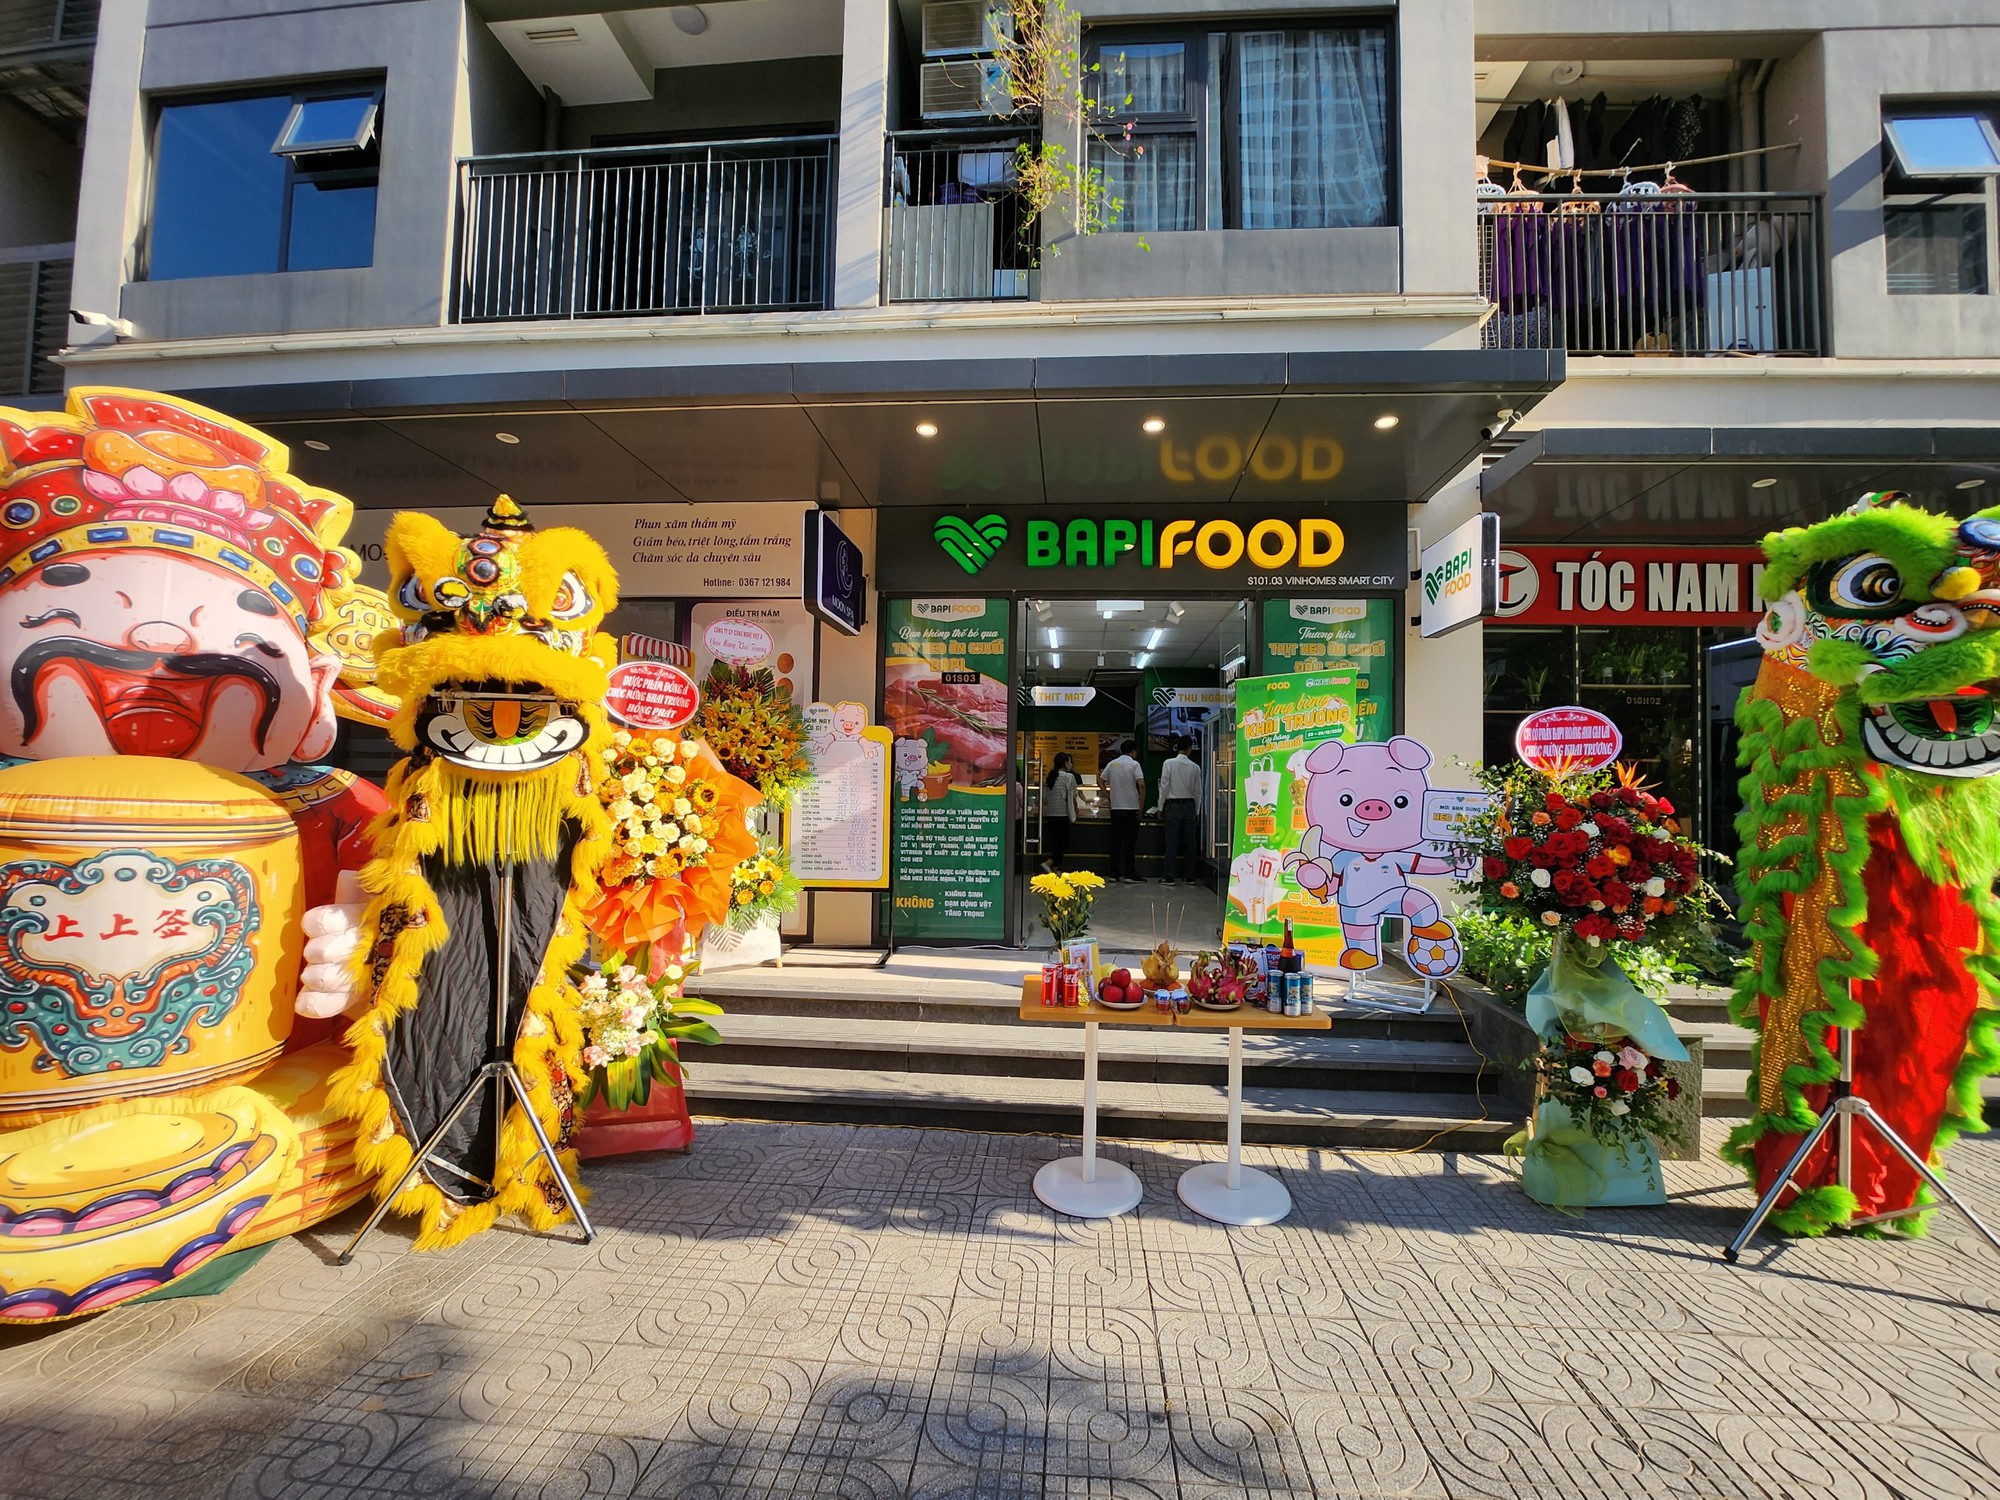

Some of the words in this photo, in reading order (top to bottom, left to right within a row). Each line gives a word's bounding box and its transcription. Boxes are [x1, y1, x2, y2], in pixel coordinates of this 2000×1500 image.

[634, 518, 661, 529] Phun
[665, 519, 687, 529] xăm
[1027, 519, 1154, 568] BAPI
[1159, 518, 1345, 569] FOOD
[632, 552, 663, 563] Chăm
[666, 552, 683, 563] sóc
[686, 552, 699, 562] da
[703, 552, 739, 564] chuyên
[742, 552, 762, 562] sâu
[1445, 547, 1472, 582] BAPI
[703, 578, 735, 587] Hotline:
[738, 577, 760, 587] 0367
[1247, 576, 1283, 586] S101.03
[1284, 576, 1337, 586] VINHOMES
[1338, 576, 1371, 586] SMART
[1372, 576, 1395, 586] CITY
[1445, 572, 1471, 598] FOOD
[1556, 551, 1635, 612] TÓC
[1648, 562, 1739, 612] NAM
[761, 608, 780, 617] NÁM
[930, 604, 951, 613] BAPI
[952, 605, 980, 613] FOOD
[1310, 606, 1331, 615] BAPI
[1332, 607, 1361, 615] FOOD
[899, 626, 921, 640] Bạn
[922, 628, 950, 640] không
[980, 630, 999, 639] qua
[922, 641, 947, 654] HEO
[949, 640, 966, 654] ĂN
[968, 638, 1004, 654] CHUỐI
[1268, 642, 1298, 658] THỊT
[1299, 643, 1326, 656] HEO
[1327, 641, 1346, 656] ĂN
[1347, 640, 1385, 656] CHUỐI
[929, 658, 966, 672] BAPI
[945, 674, 976, 682] 01S03
[1266, 681, 1291, 691] FOOD
[1244, 718, 1280, 740] KHAI
[1283, 705, 1351, 732] TRƯƠNG
[1258, 860, 1272, 878] 10
[896, 894, 934, 908] KHÔNG
[944, 909, 962, 917] TĂNG
[963, 910, 984, 918] TRỌNG
